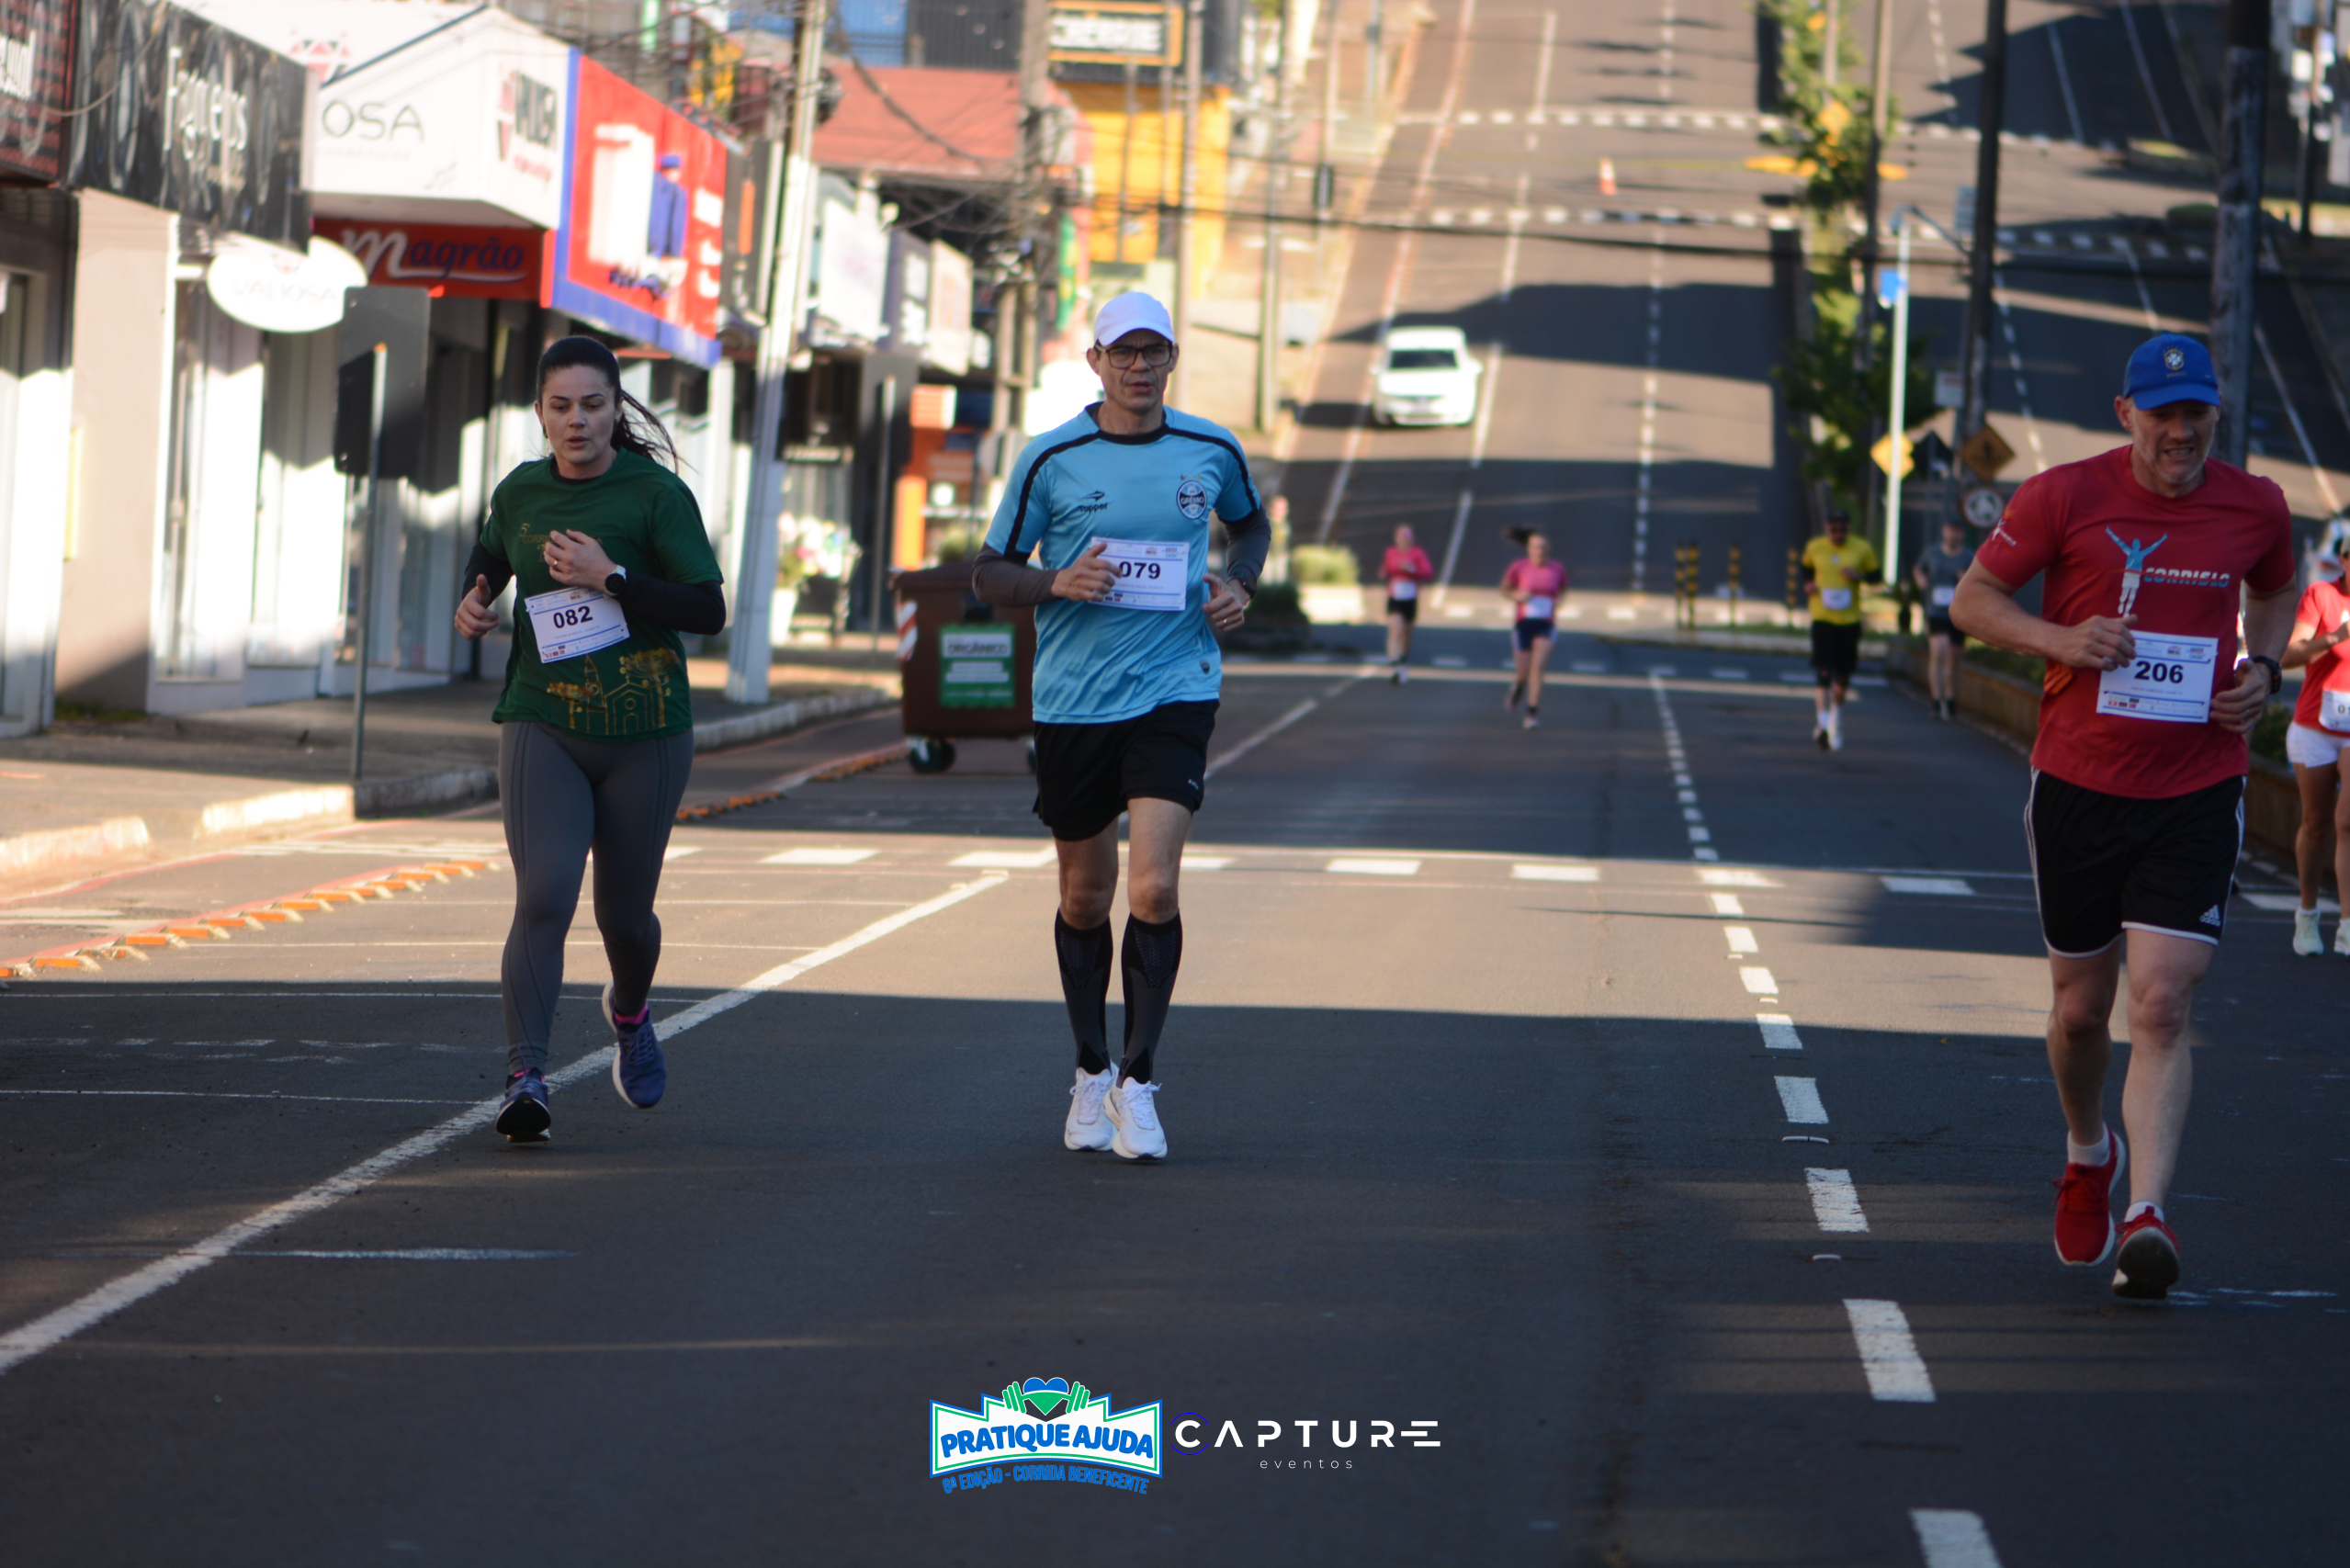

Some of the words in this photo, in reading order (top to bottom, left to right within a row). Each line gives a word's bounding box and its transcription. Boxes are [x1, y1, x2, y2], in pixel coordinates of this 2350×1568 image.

[231, 278, 338, 305] VALIOSA
[1119, 561, 1161, 580] 079
[2143, 567, 2231, 588] CORRIELO
[553, 605, 593, 628] 082
[2134, 660, 2184, 683] 206
